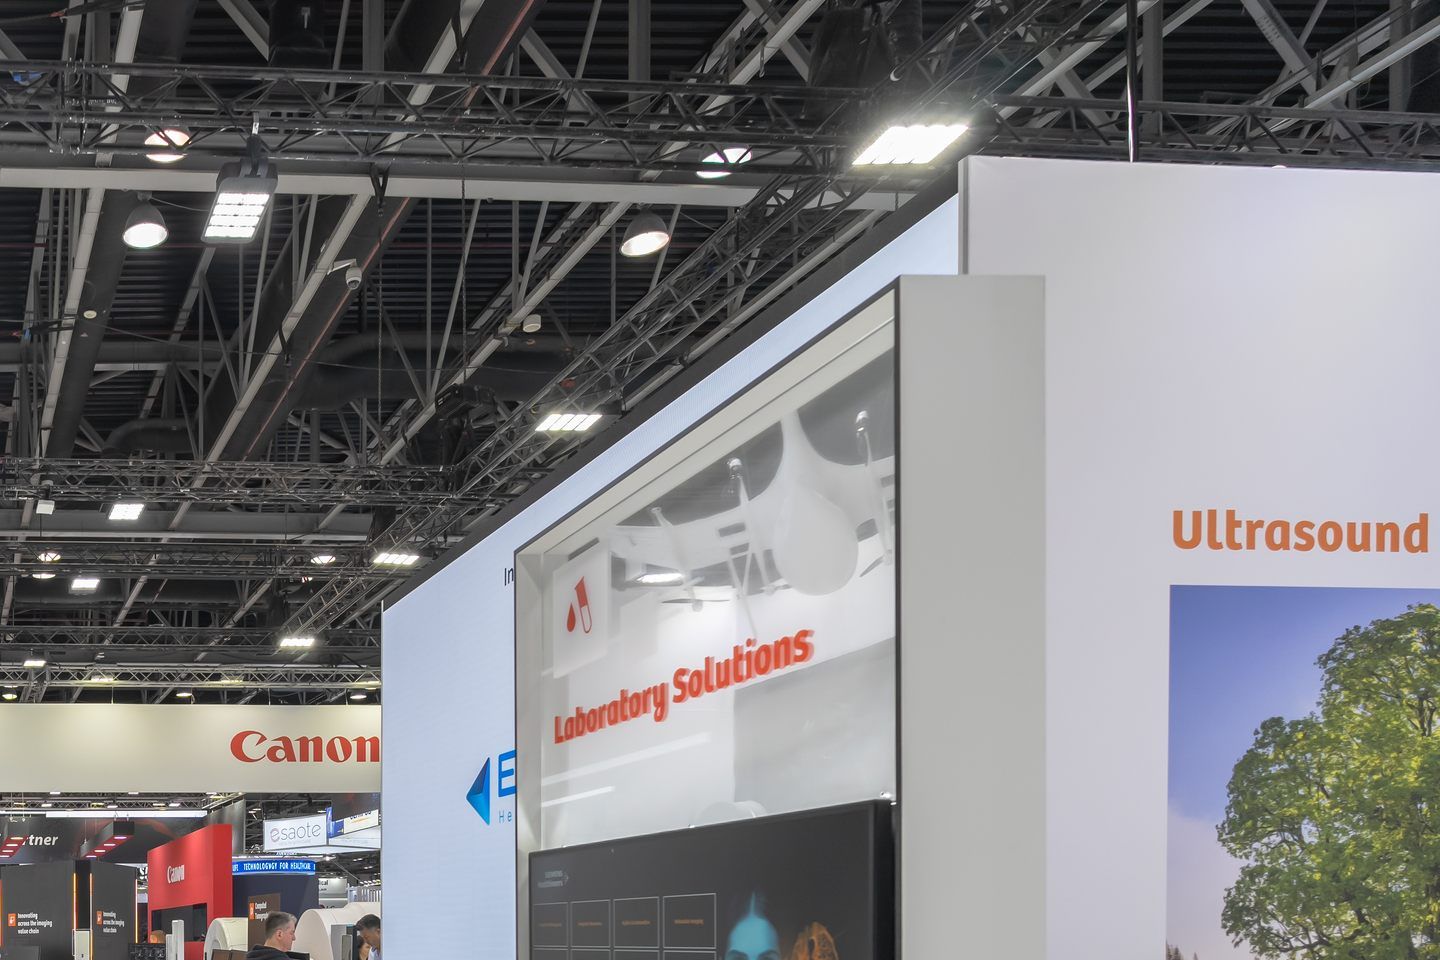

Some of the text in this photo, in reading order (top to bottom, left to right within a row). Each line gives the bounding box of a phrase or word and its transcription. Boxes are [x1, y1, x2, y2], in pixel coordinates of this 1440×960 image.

[1172, 508, 1429, 554] Ultrasound
[554, 629, 816, 744] Laboratory Solutions
[230, 730, 380, 763] Canon
[270, 822, 322, 843] esaote
[166, 864, 185, 884] Canon
[17, 912, 38, 920] Innovating
[37, 920, 53, 928] imaging
